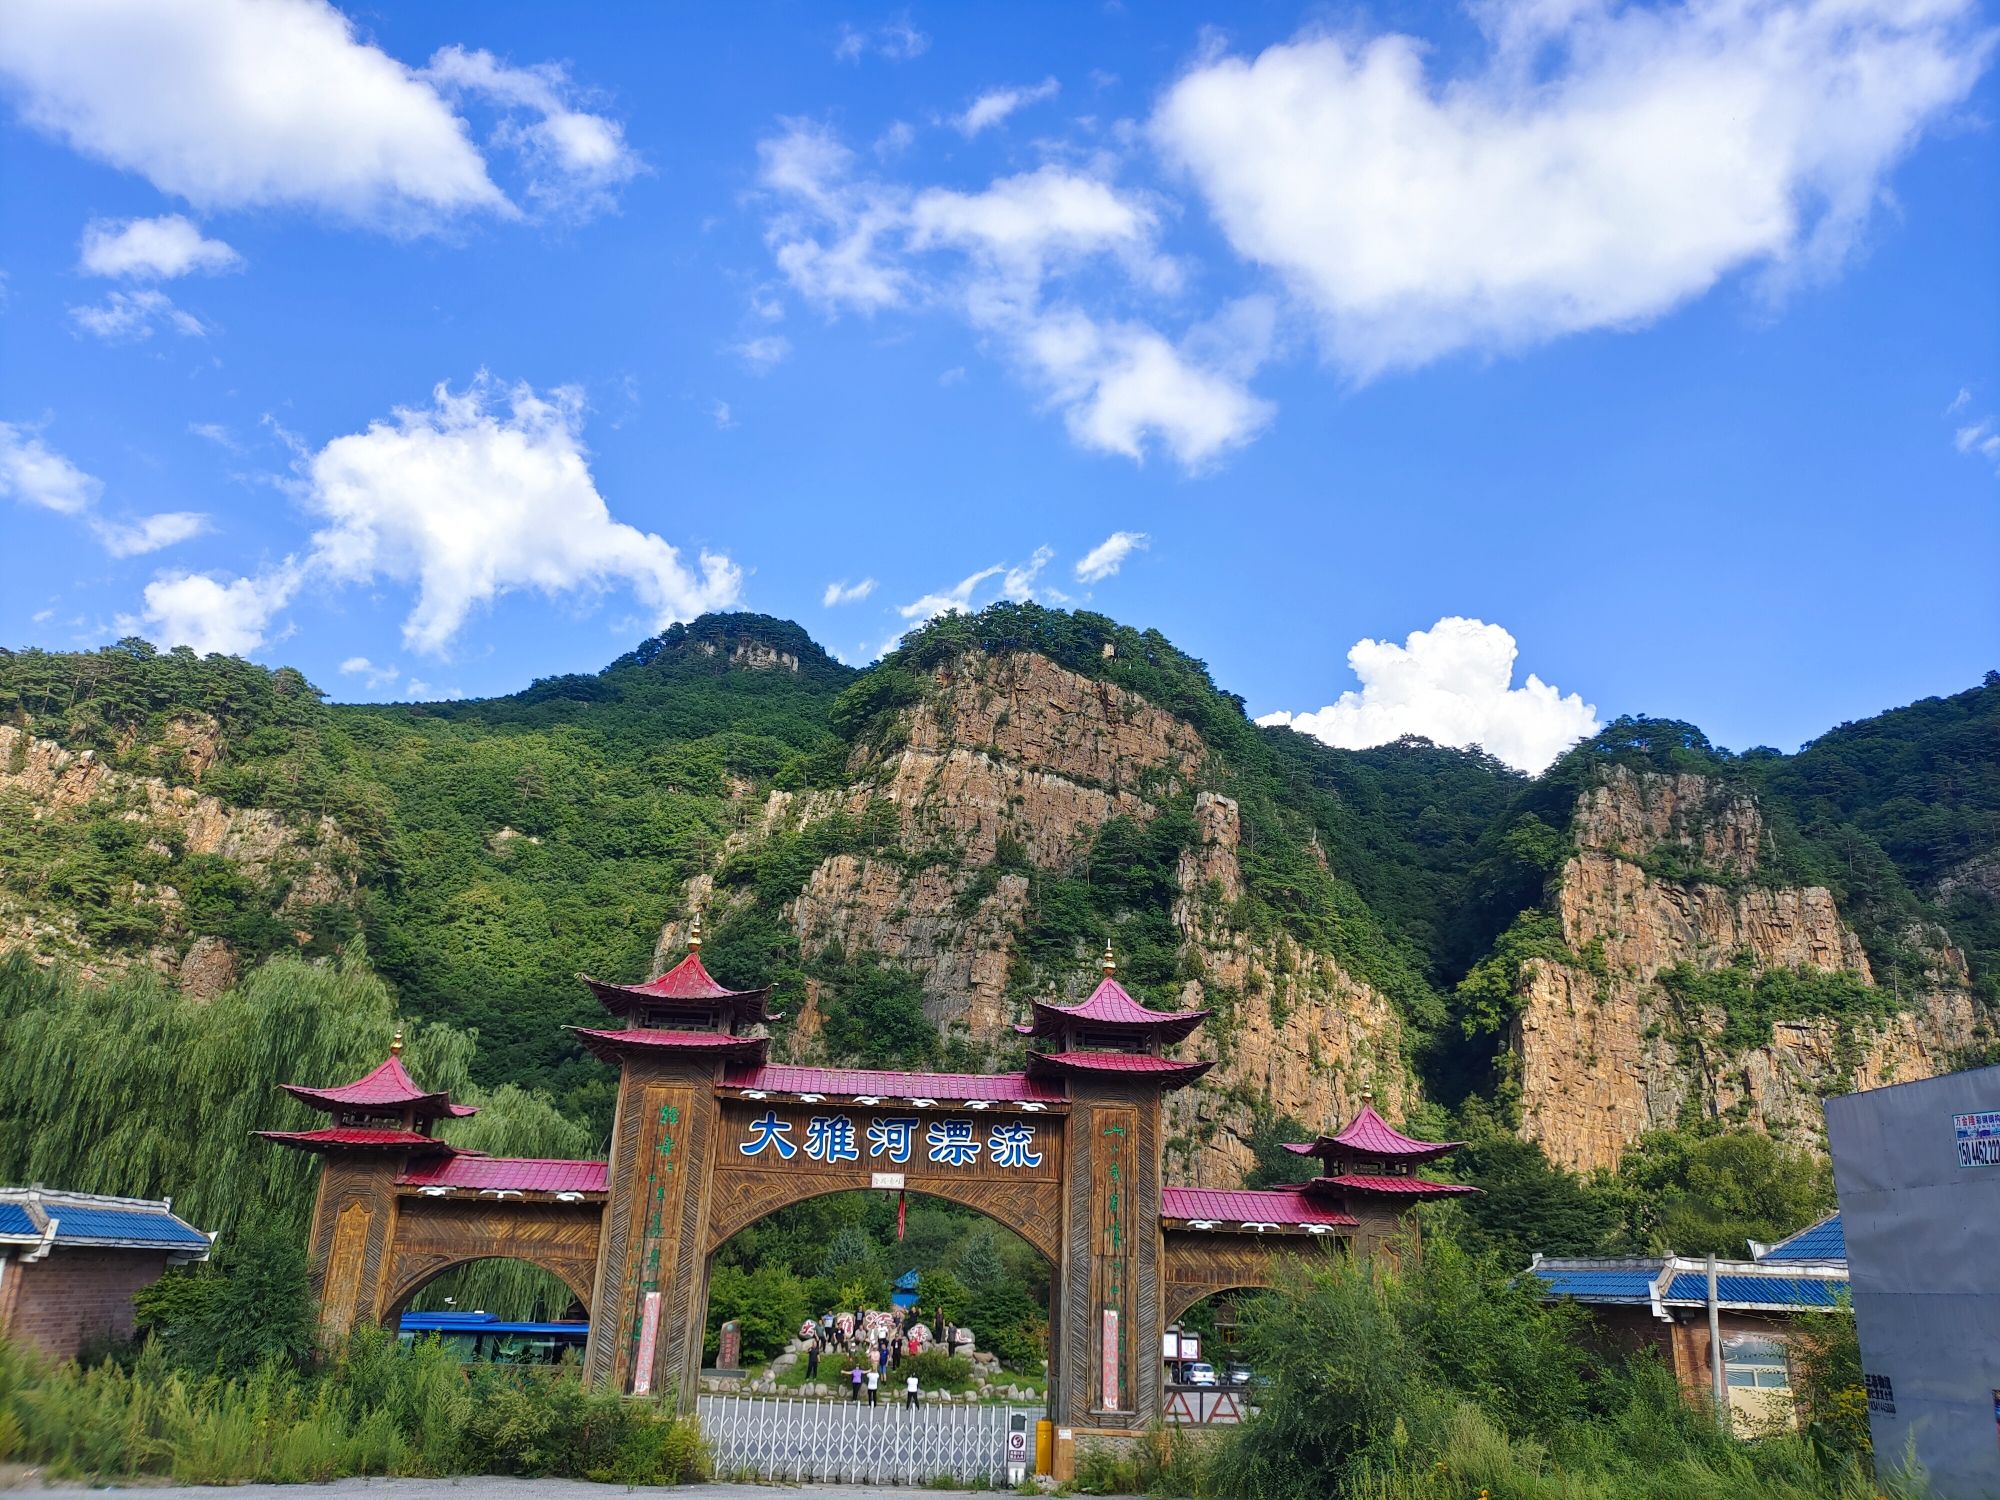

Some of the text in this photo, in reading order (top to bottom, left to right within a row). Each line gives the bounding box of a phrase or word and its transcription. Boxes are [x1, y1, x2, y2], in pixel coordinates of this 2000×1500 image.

[739, 1110, 1043, 1168] 大雅河漂流
